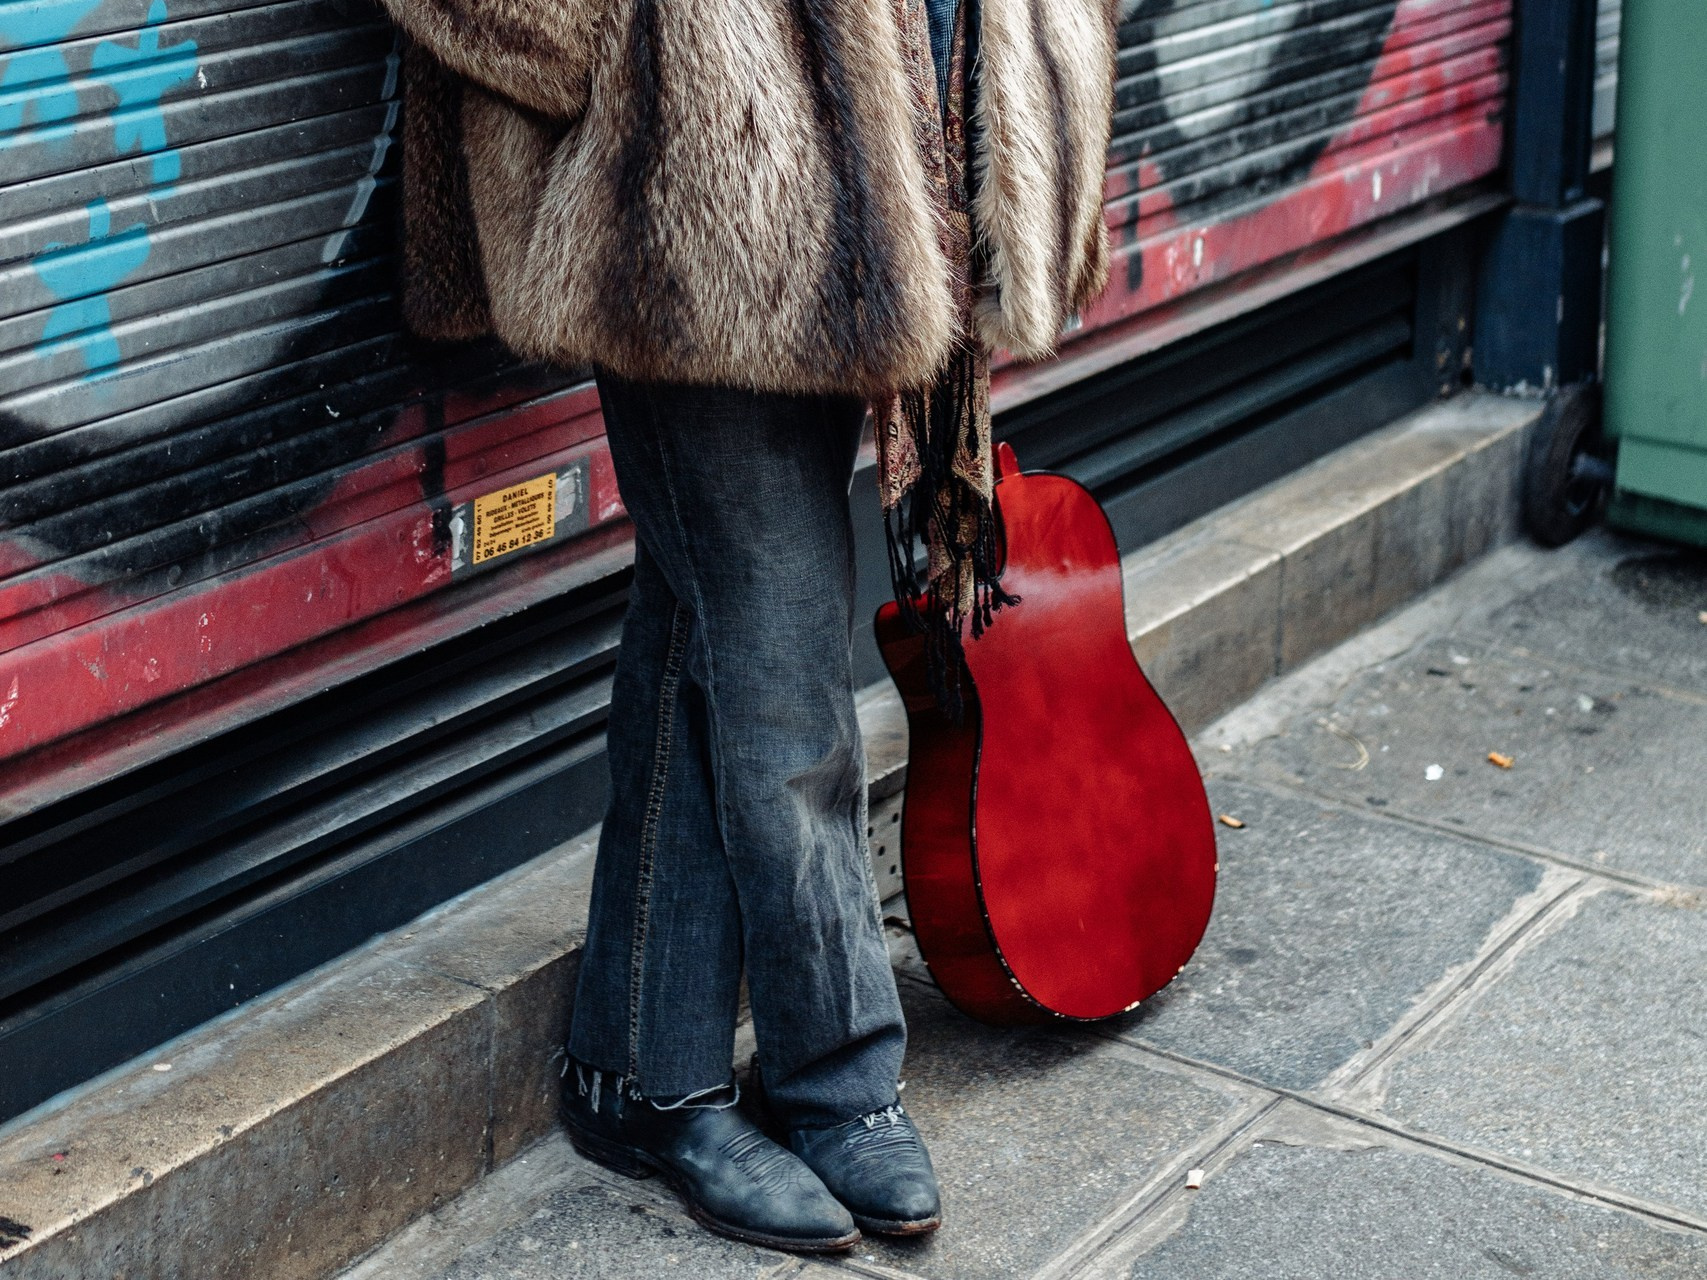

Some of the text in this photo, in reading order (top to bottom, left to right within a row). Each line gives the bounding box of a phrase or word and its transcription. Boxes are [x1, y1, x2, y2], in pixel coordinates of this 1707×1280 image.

[502, 488, 528, 502] DANIEL
[486, 505, 507, 517] RIDEAUX
[494, 511, 514, 523] GRILLES
[518, 503, 536, 514] VOLETS
[484, 529, 543, 558] 06 46 84 12 36
